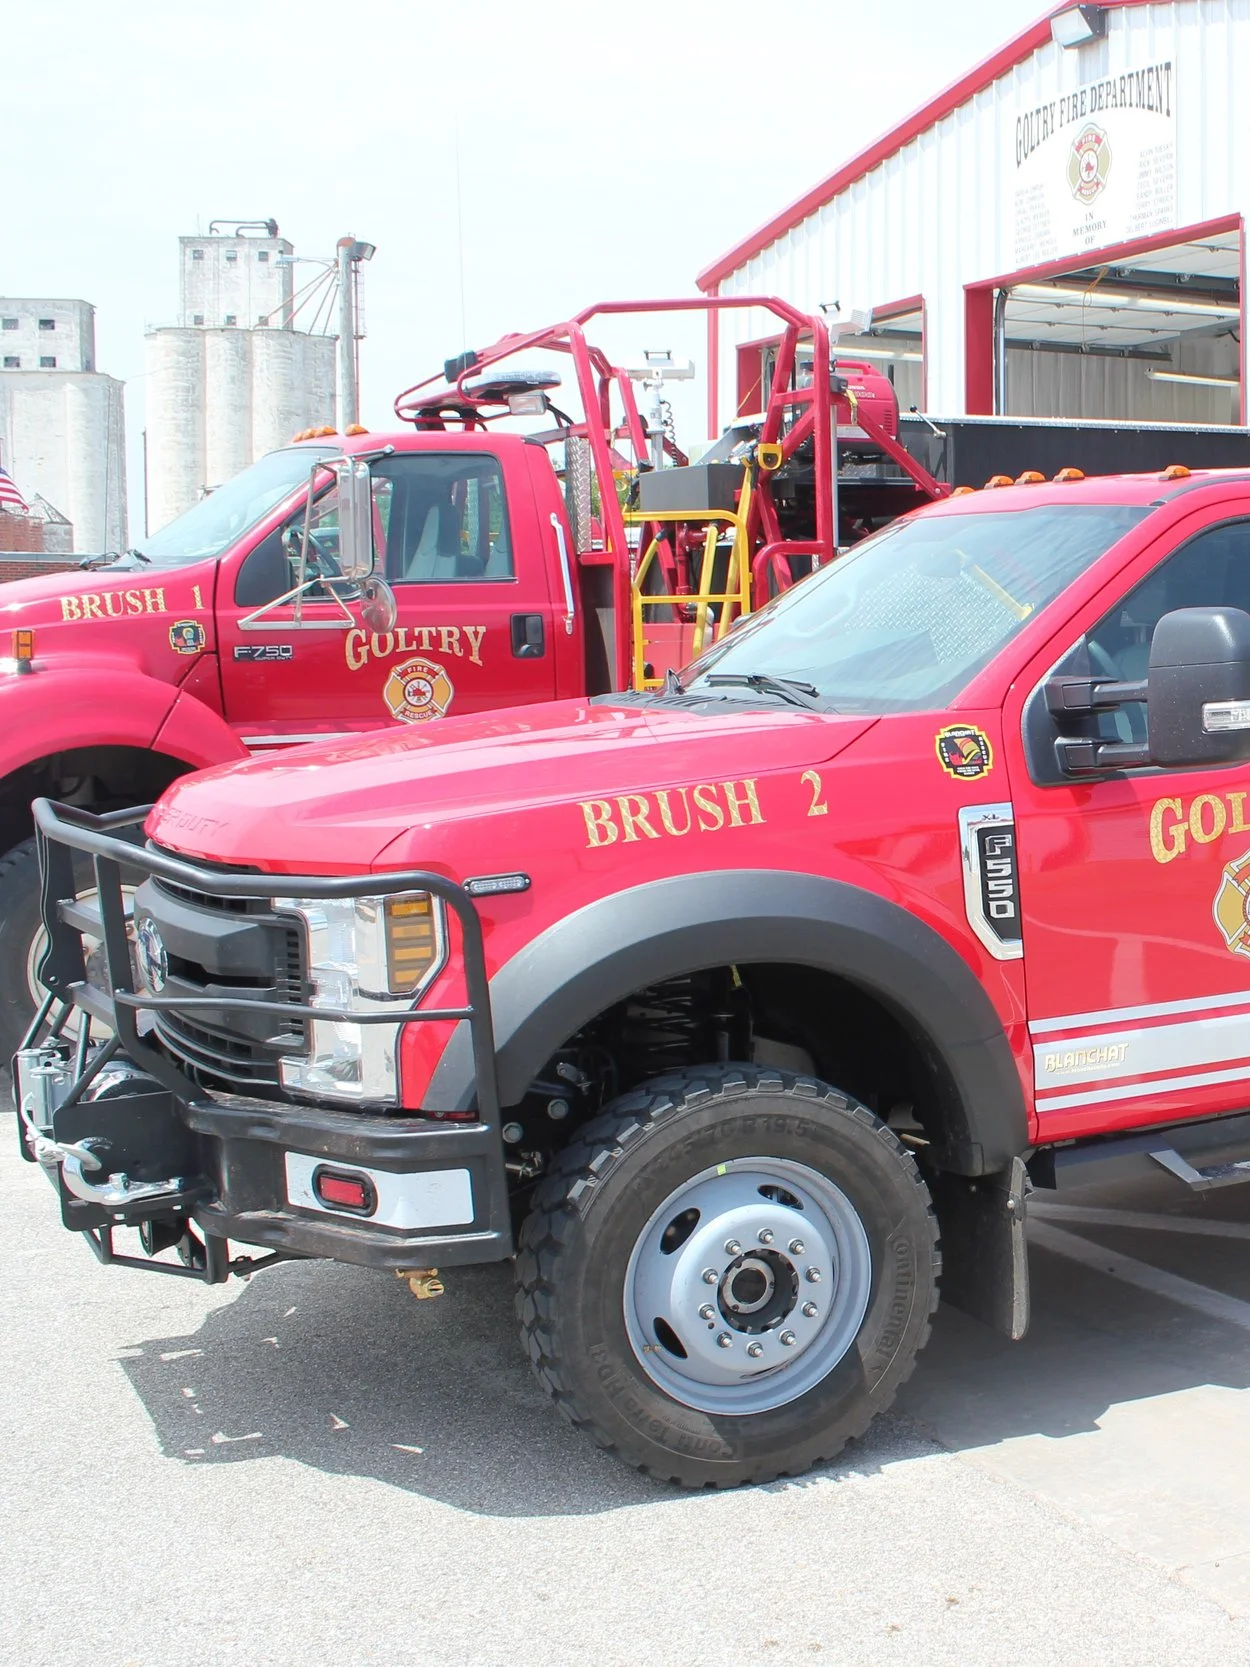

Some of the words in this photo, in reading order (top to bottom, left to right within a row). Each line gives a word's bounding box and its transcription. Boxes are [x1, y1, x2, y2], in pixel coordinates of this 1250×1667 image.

[1016, 102, 1055, 168] GOLTRY
[1060, 90, 1087, 128] FIRE
[1090, 61, 1171, 117] DEPARTMENT
[1072, 220, 1107, 237] MEMORY
[1085, 212, 1094, 222] IN
[1085, 235, 1095, 245] OF
[61, 587, 168, 621] BRUSH
[193, 585, 205, 610] 1
[345, 625, 486, 670] GOLTRY
[404, 710, 433, 719] RESCUE
[578, 778, 766, 849] BRUSH
[800, 770, 828, 817] 2
[981, 813, 1000, 821] XL
[1045, 1042, 1129, 1072] BLANCHAT
[875, 1233, 914, 1359] Continental
